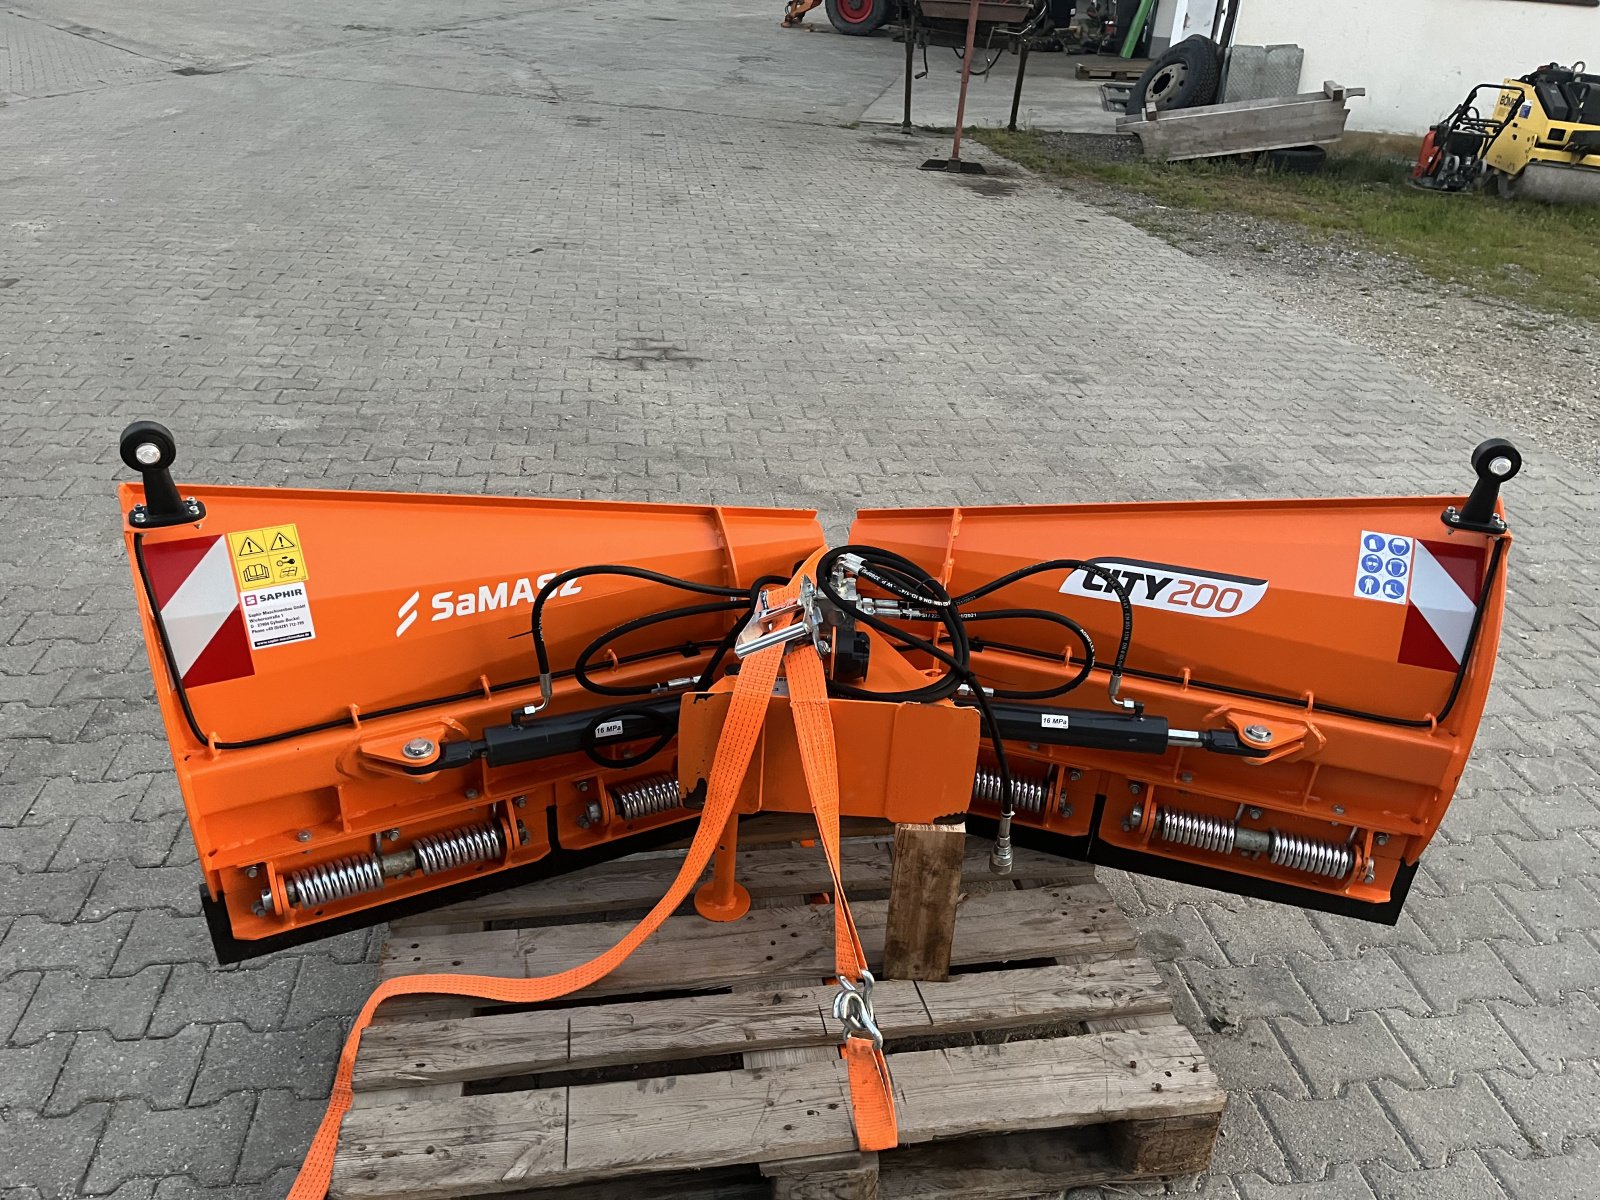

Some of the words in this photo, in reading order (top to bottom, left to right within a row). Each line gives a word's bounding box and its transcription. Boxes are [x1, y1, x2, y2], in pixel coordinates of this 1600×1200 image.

[1499, 94, 1517, 106] BOM
[259, 589, 302, 602] SAPHIR
[1082, 568, 1174, 600] CITY
[1168, 580, 1243, 614] 200
